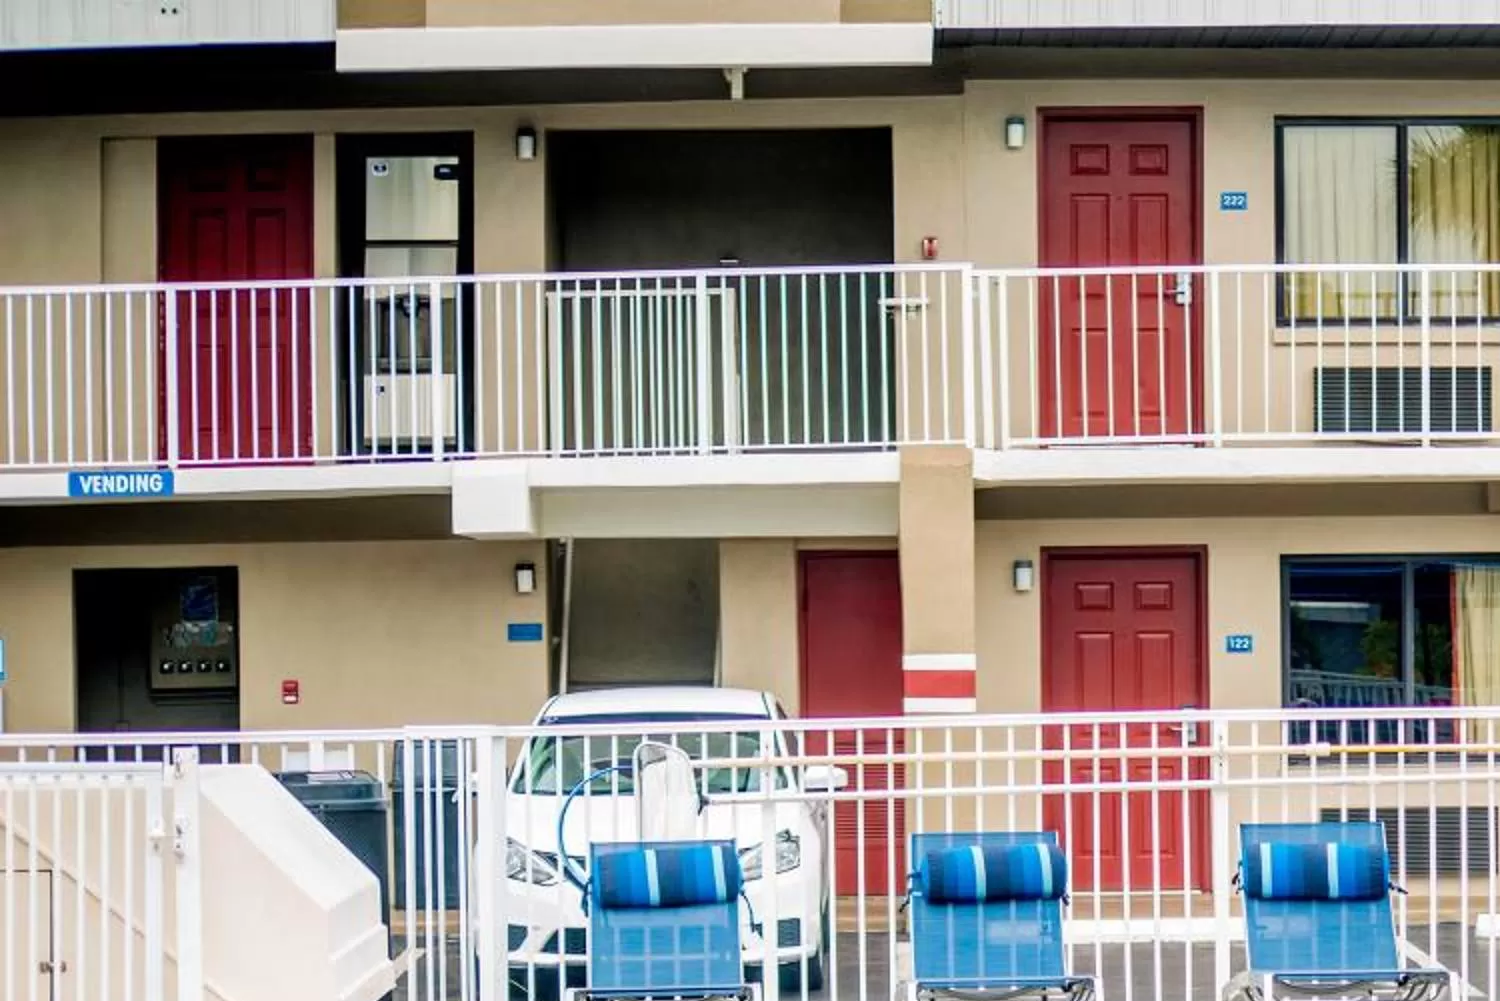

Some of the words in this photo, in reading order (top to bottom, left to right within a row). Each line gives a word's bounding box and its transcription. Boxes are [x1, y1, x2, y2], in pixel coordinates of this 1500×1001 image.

[1223, 195, 1245, 206] 222
[80, 474, 163, 494] VENDING
[1230, 637, 1250, 649] 122
